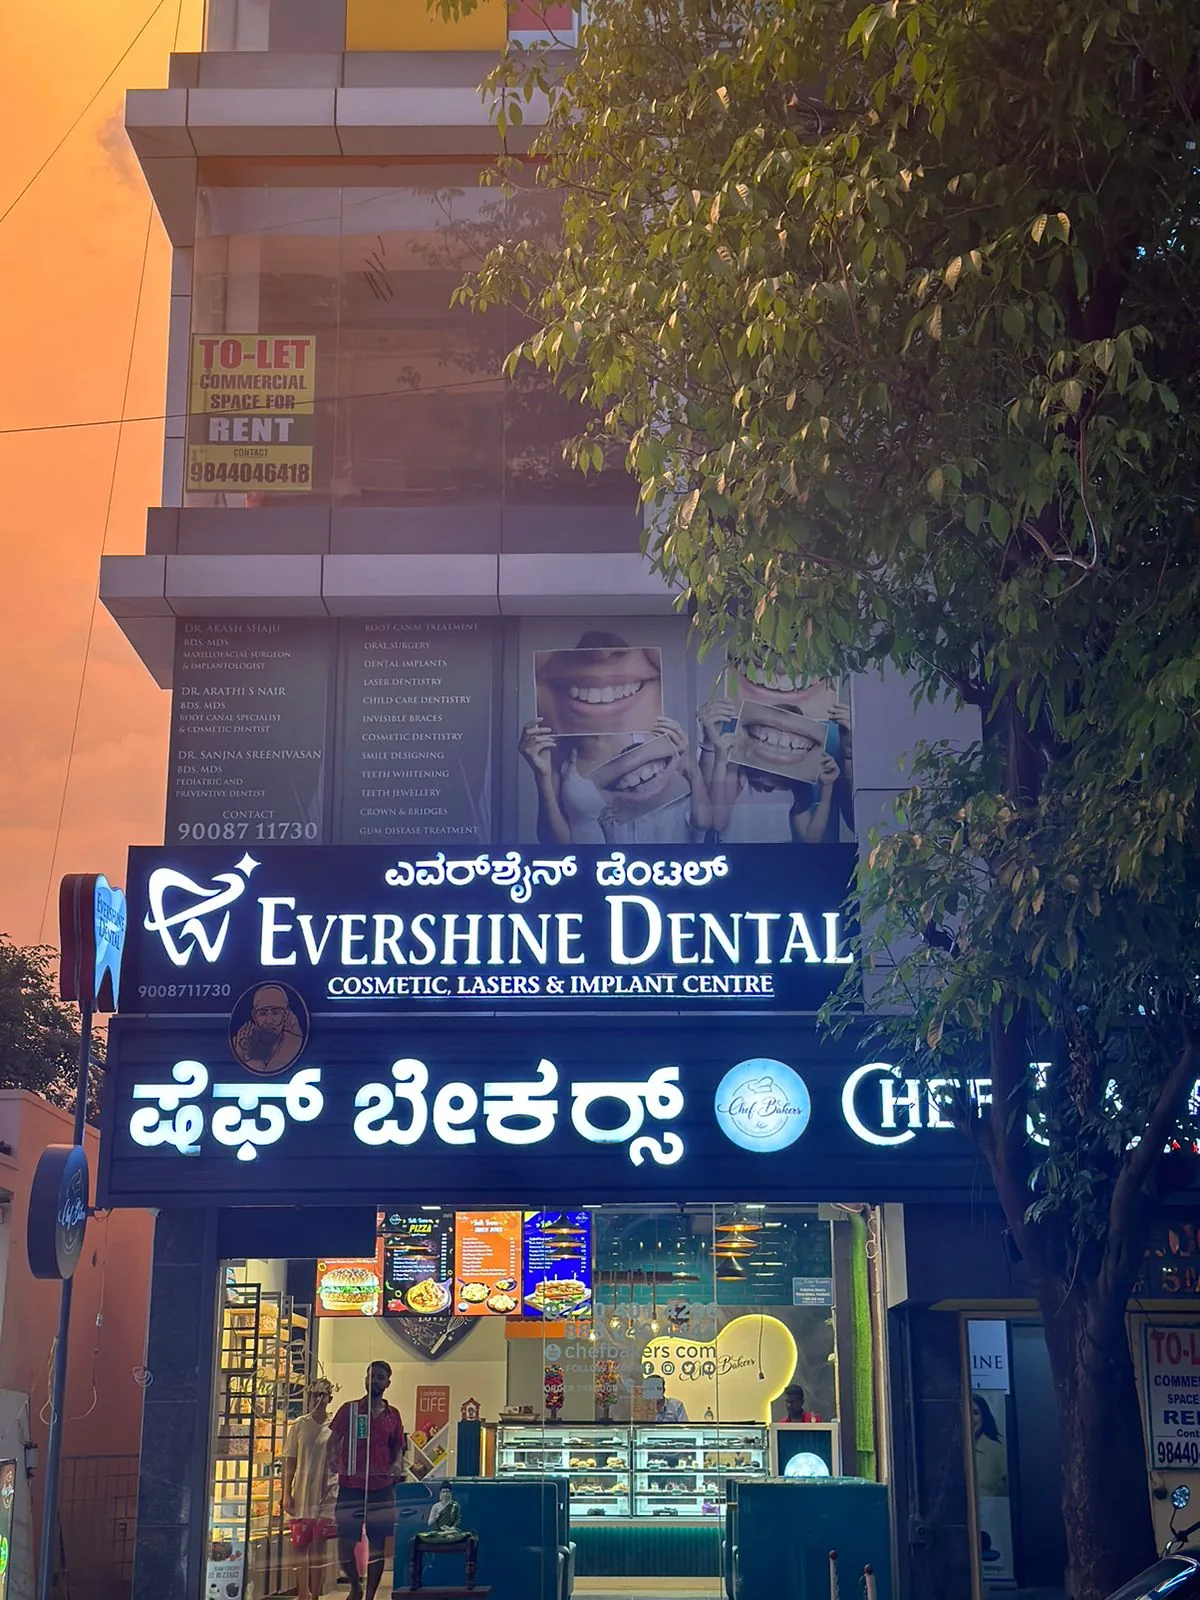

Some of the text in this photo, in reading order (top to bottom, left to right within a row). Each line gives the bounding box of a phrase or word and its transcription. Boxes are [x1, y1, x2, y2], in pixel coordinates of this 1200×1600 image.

[199, 339, 310, 369] TO-LET
[200, 374, 307, 390] COMMERCIAL
[210, 394, 295, 410] SPACE FOR
[209, 417, 294, 442] RENT
[234, 449, 268, 457] CONTACT
[190, 462, 310, 483] 9844046418
[364, 642, 431, 650] ORAL SURGERY
[364, 660, 447, 668] DENTAL IMPLANTS
[364, 678, 442, 686] LASER DENTISTRY
[181, 687, 286, 696] DR. ARATHI S NAIR
[363, 696, 472, 705] CHILD CARE DENTISTRY
[204, 702, 226, 710] MDS
[363, 714, 443, 723] INVISIBLE BRACES
[362, 733, 463, 741] COSMETIC DENTISTRY
[178, 750, 322, 761] DR. SANJNA SREENIVASAN
[361, 752, 444, 760] SMILE DESIGNING
[393, 770, 449, 778] WHITENING
[176, 778, 222, 786] PEDIATRIC
[175, 790, 227, 798] PREVENTIVE
[361, 789, 441, 798] TEETH JEWELLERY
[223, 810, 276, 819] CONTACT
[360, 808, 448, 816] CROWN & BRIDGES
[178, 822, 318, 840] 90087 11730
[360, 826, 479, 835] GUM DISEASE TREATMENT
[595, 851, 729, 887] ಡೆಂಟಲ್
[257, 894, 854, 966] EVERSHINE DENTAL
[326, 973, 774, 996] COSMETIC, LASERS & IMPLANT CENTRE
[138, 982, 232, 999] 9008711730
[717, 1096, 803, 1120] Chef Bakers
[408, 1224, 432, 1234] PIZZA
[716, 1355, 756, 1376] Bakers
[1154, 1375, 1200, 1388] COMME
[1167, 1394, 1199, 1405] SPACE
[419, 1397, 447, 1413] LIFE
